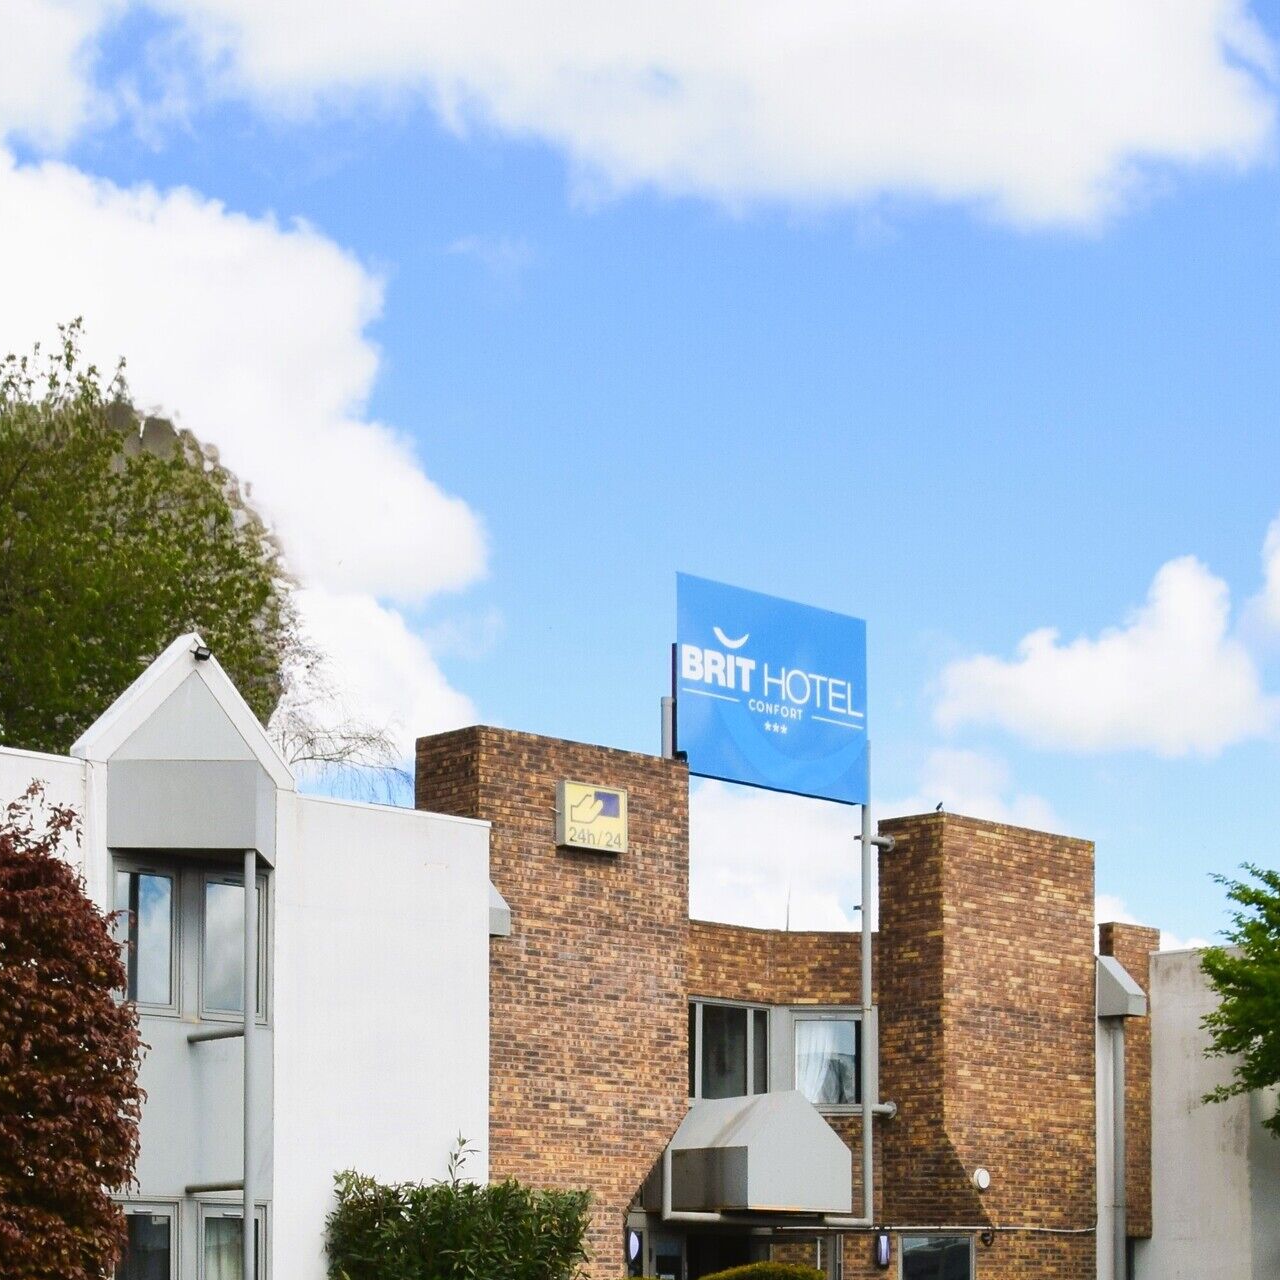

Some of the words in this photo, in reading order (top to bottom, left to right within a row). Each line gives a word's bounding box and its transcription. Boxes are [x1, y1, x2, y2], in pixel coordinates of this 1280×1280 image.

[681, 643, 756, 693] BRIT
[763, 663, 864, 718] HOTEL
[748, 698, 803, 721] CONFORT
